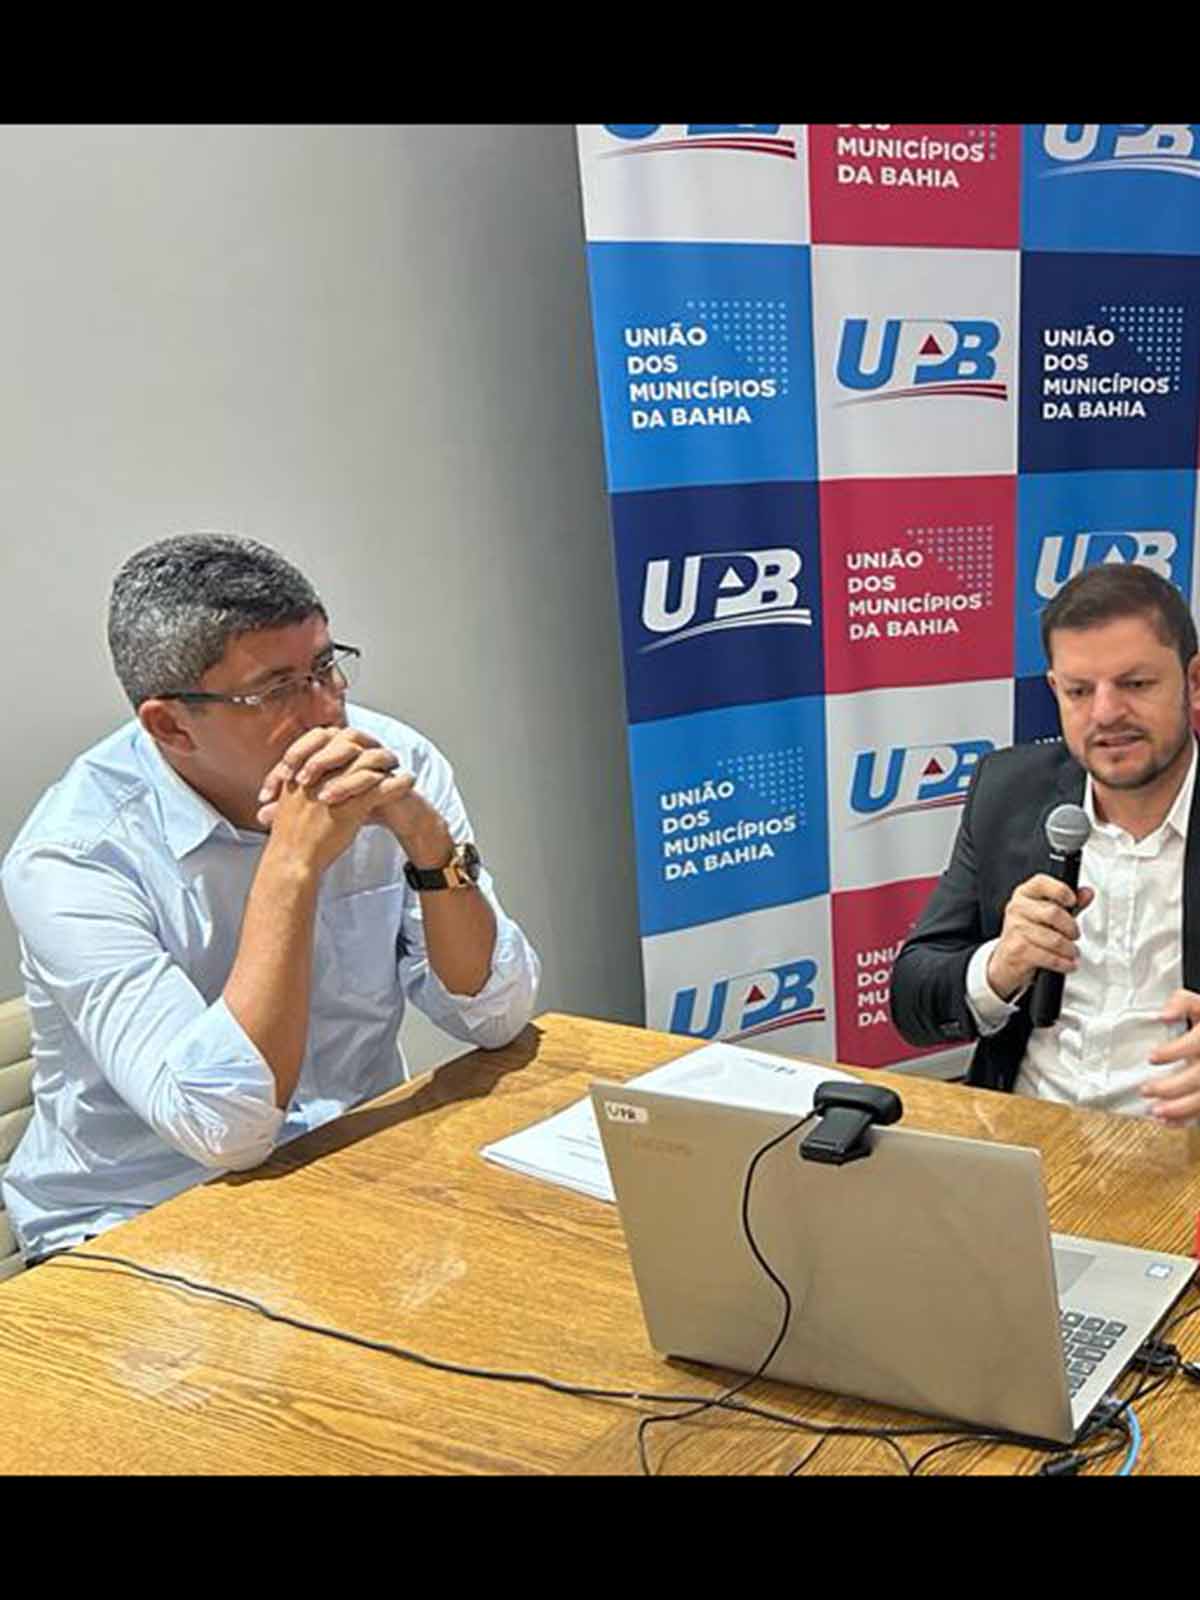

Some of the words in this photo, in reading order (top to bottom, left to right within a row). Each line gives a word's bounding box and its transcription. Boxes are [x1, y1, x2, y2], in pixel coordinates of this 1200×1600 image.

[836, 134, 985, 163] MUNICÍPIOS
[836, 165, 874, 184] DA
[880, 166, 960, 189] BAHIA
[624, 321, 708, 348] UNIÃO
[1043, 325, 1115, 347] UNIÃO
[627, 355, 678, 375] DOS
[836, 318, 1001, 391] UPB
[1043, 354, 1089, 372] DOS
[629, 375, 777, 402] MUNICÍPIOS
[1042, 373, 1170, 396] MUNICÍPIOS
[631, 409, 666, 430] DA
[671, 405, 752, 427] BAHIA
[1042, 401, 1074, 419] DA
[1078, 400, 1146, 418] BAHIA
[847, 548, 923, 571] UNIÃO
[641, 547, 802, 634] UPB
[847, 575, 896, 594] DOS
[848, 593, 983, 617] MUNICÍPIOS
[849, 622, 881, 641] DA
[887, 617, 959, 638] BAHIA
[660, 780, 735, 812] UNIÃO
[662, 812, 711, 834] DOS
[663, 815, 797, 858] MUNICÍPIOS
[664, 861, 698, 881] DA
[704, 842, 775, 873] BAHIA
[857, 942, 902, 969] UNI
[857, 969, 892, 988] DO
[669, 958, 820, 1041] UPB
[857, 1008, 887, 1027] DA
